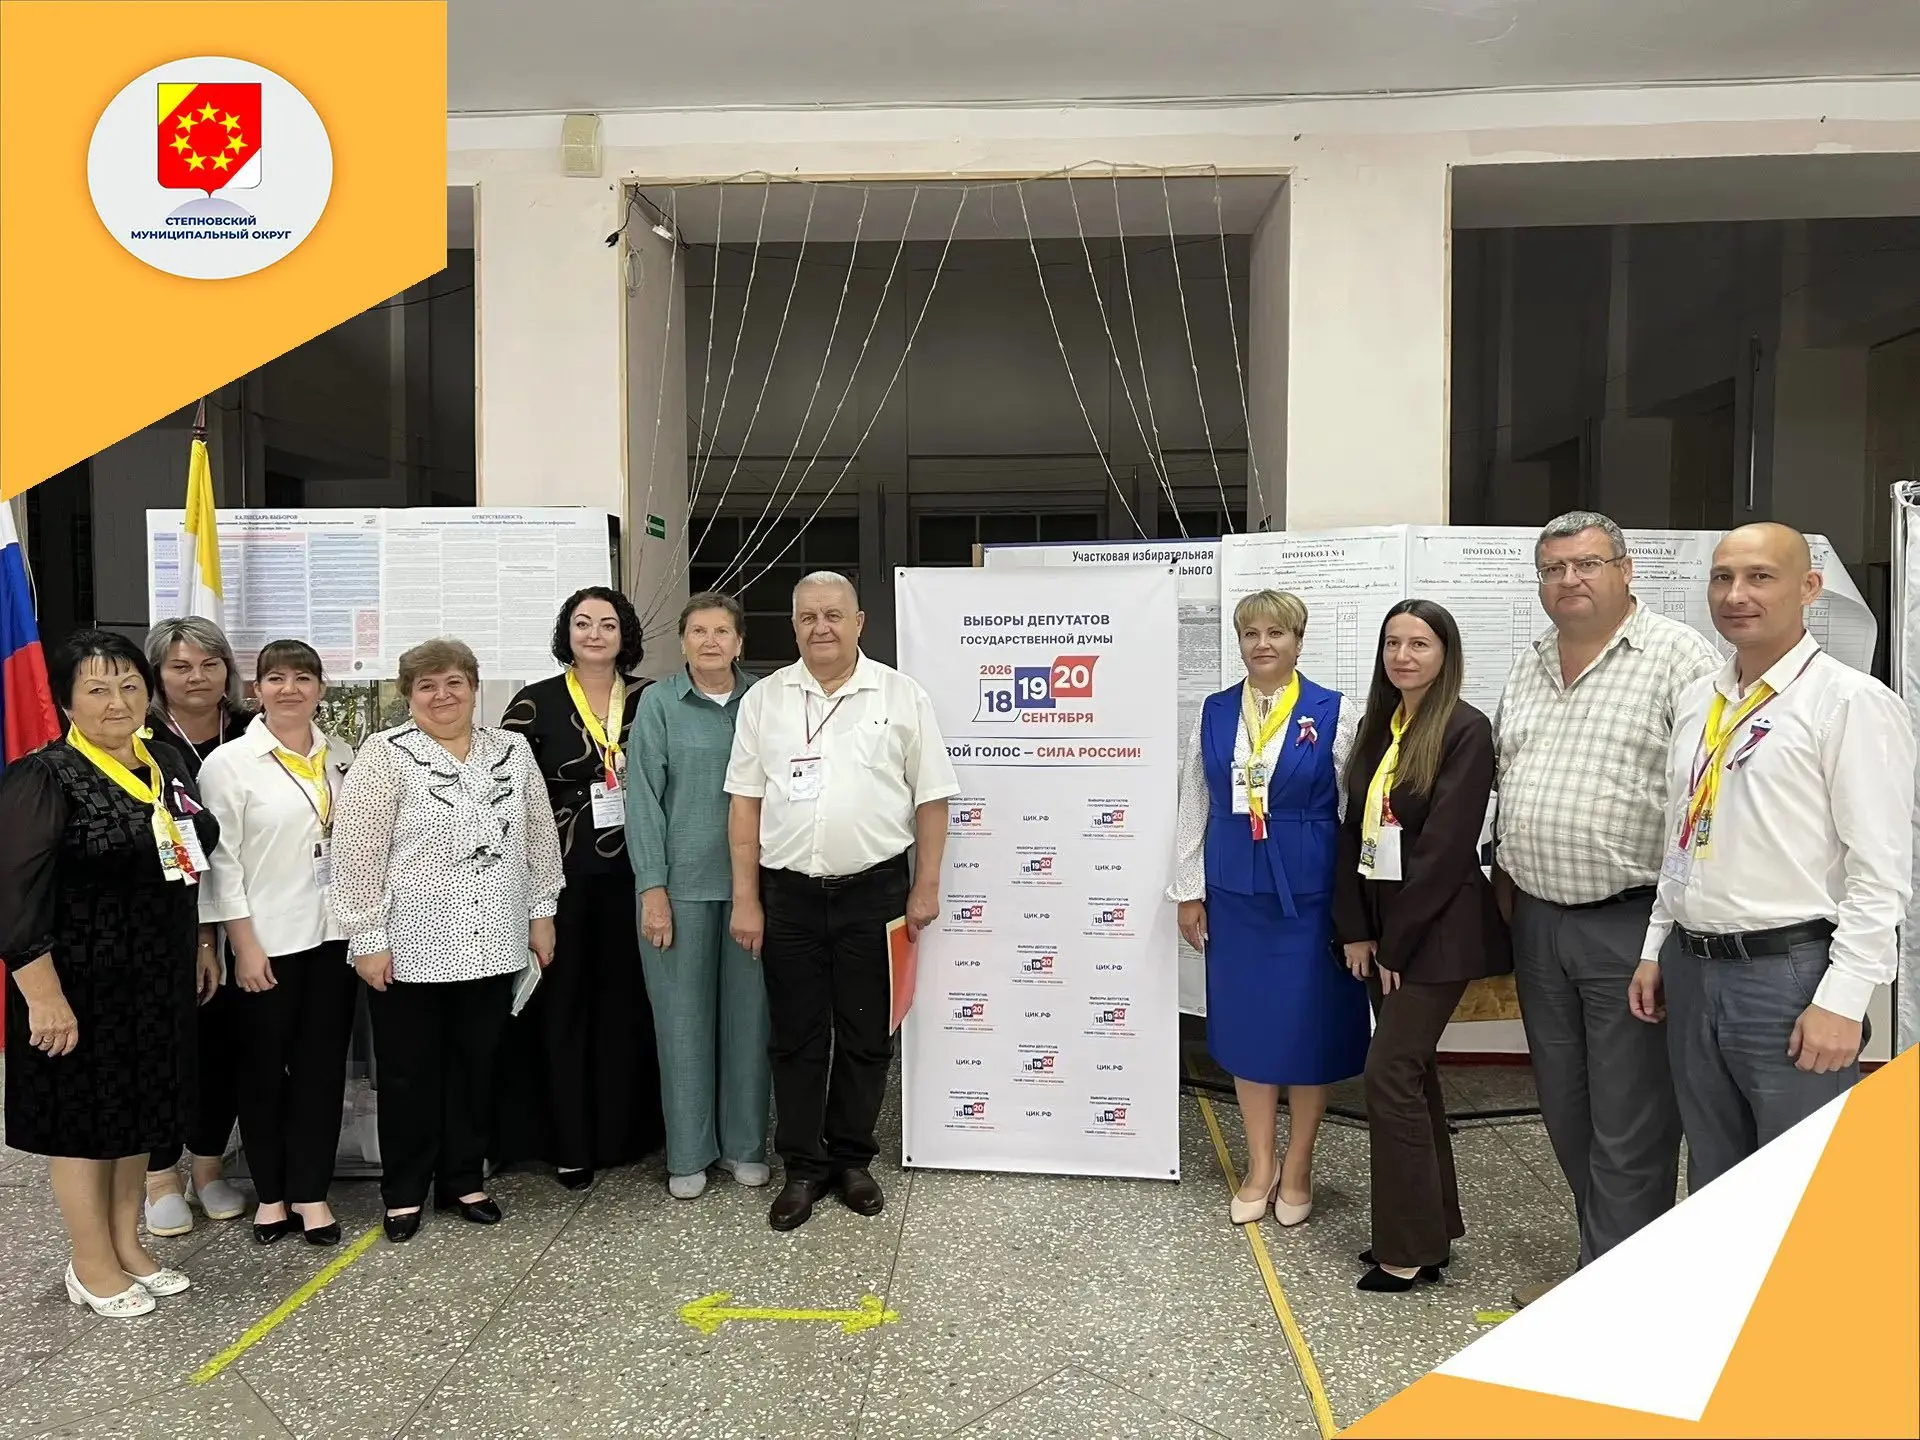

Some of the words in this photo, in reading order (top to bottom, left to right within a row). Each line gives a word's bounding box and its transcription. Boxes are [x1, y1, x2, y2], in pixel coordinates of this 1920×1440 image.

[1072, 551, 1129, 562] Участковая
[1132, 549, 1214, 562] избирательная
[964, 616, 1023, 626] ВЫБОРЫ
[1028, 615, 1110, 627] ДЕПУТАТОВ
[960, 633, 1074, 645] ГОСУДАРСТВЕННОЙ
[1077, 635, 1112, 645] ДУМЫ
[980, 665, 1012, 675] 2026
[985, 691, 1012, 712] 18
[1018, 677, 1047, 700] 19
[1054, 665, 1089, 688] 20
[1022, 713, 1093, 723] СЕНТЯБРЯ
[946, 744, 971, 757] ВОЙ
[976, 747, 1020, 758] ГОЛОС
[1037, 747, 1075, 758] СИЛА
[1078, 747, 1141, 758] РОССИИ!
